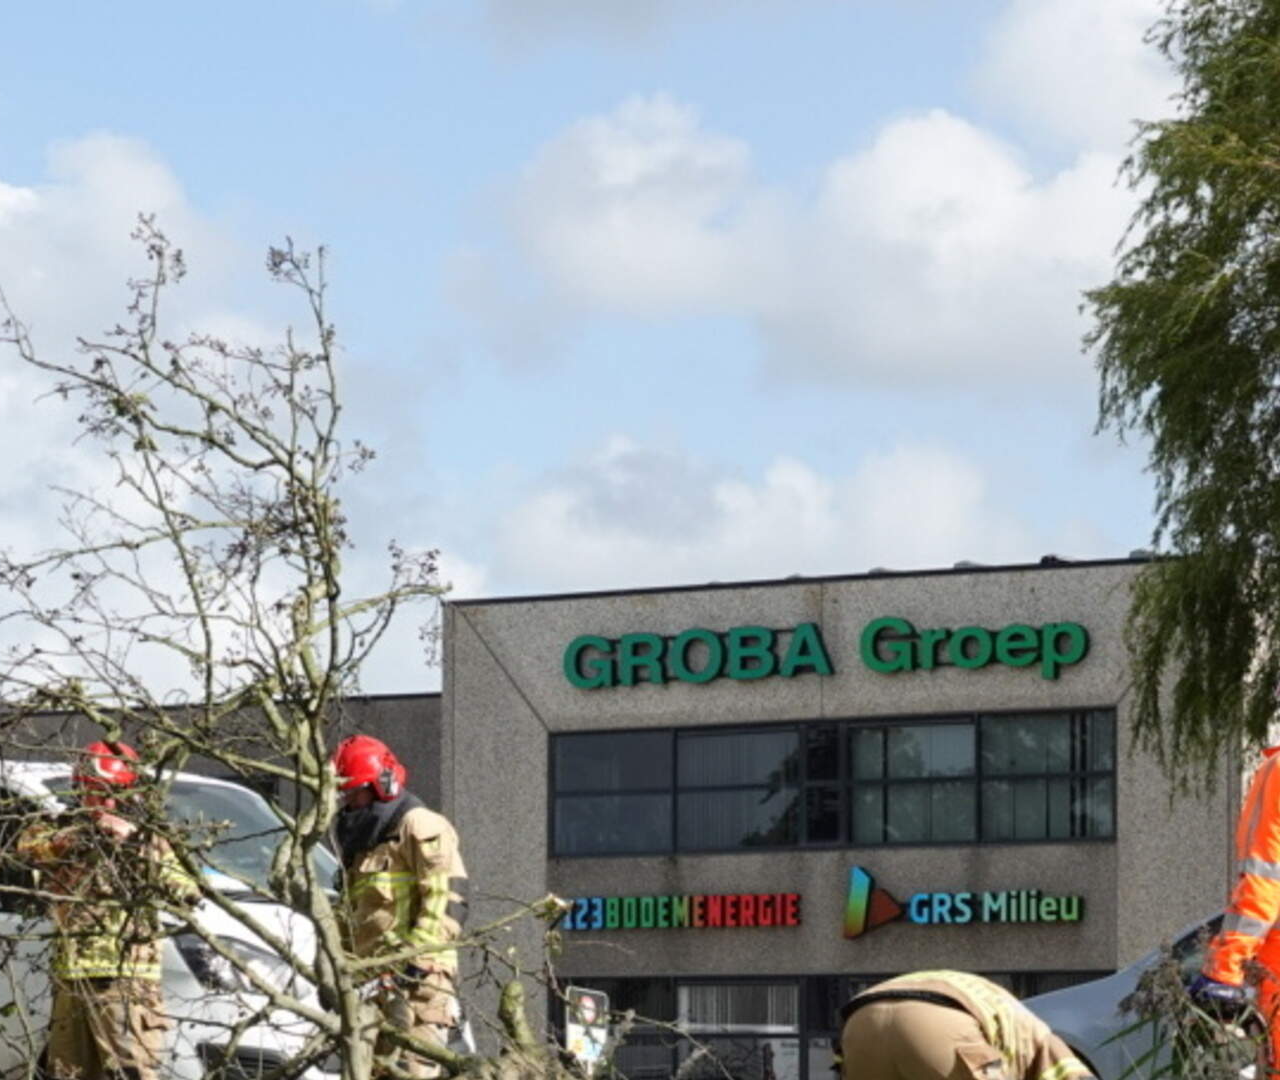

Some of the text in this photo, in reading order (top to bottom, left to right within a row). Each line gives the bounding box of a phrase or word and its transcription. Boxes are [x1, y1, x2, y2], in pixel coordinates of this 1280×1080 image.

[562, 617, 1089, 690] GROBA Groep
[563, 894, 799, 930] 123BODEMENERGIE
[909, 889, 1079, 924] GRS Milieu
